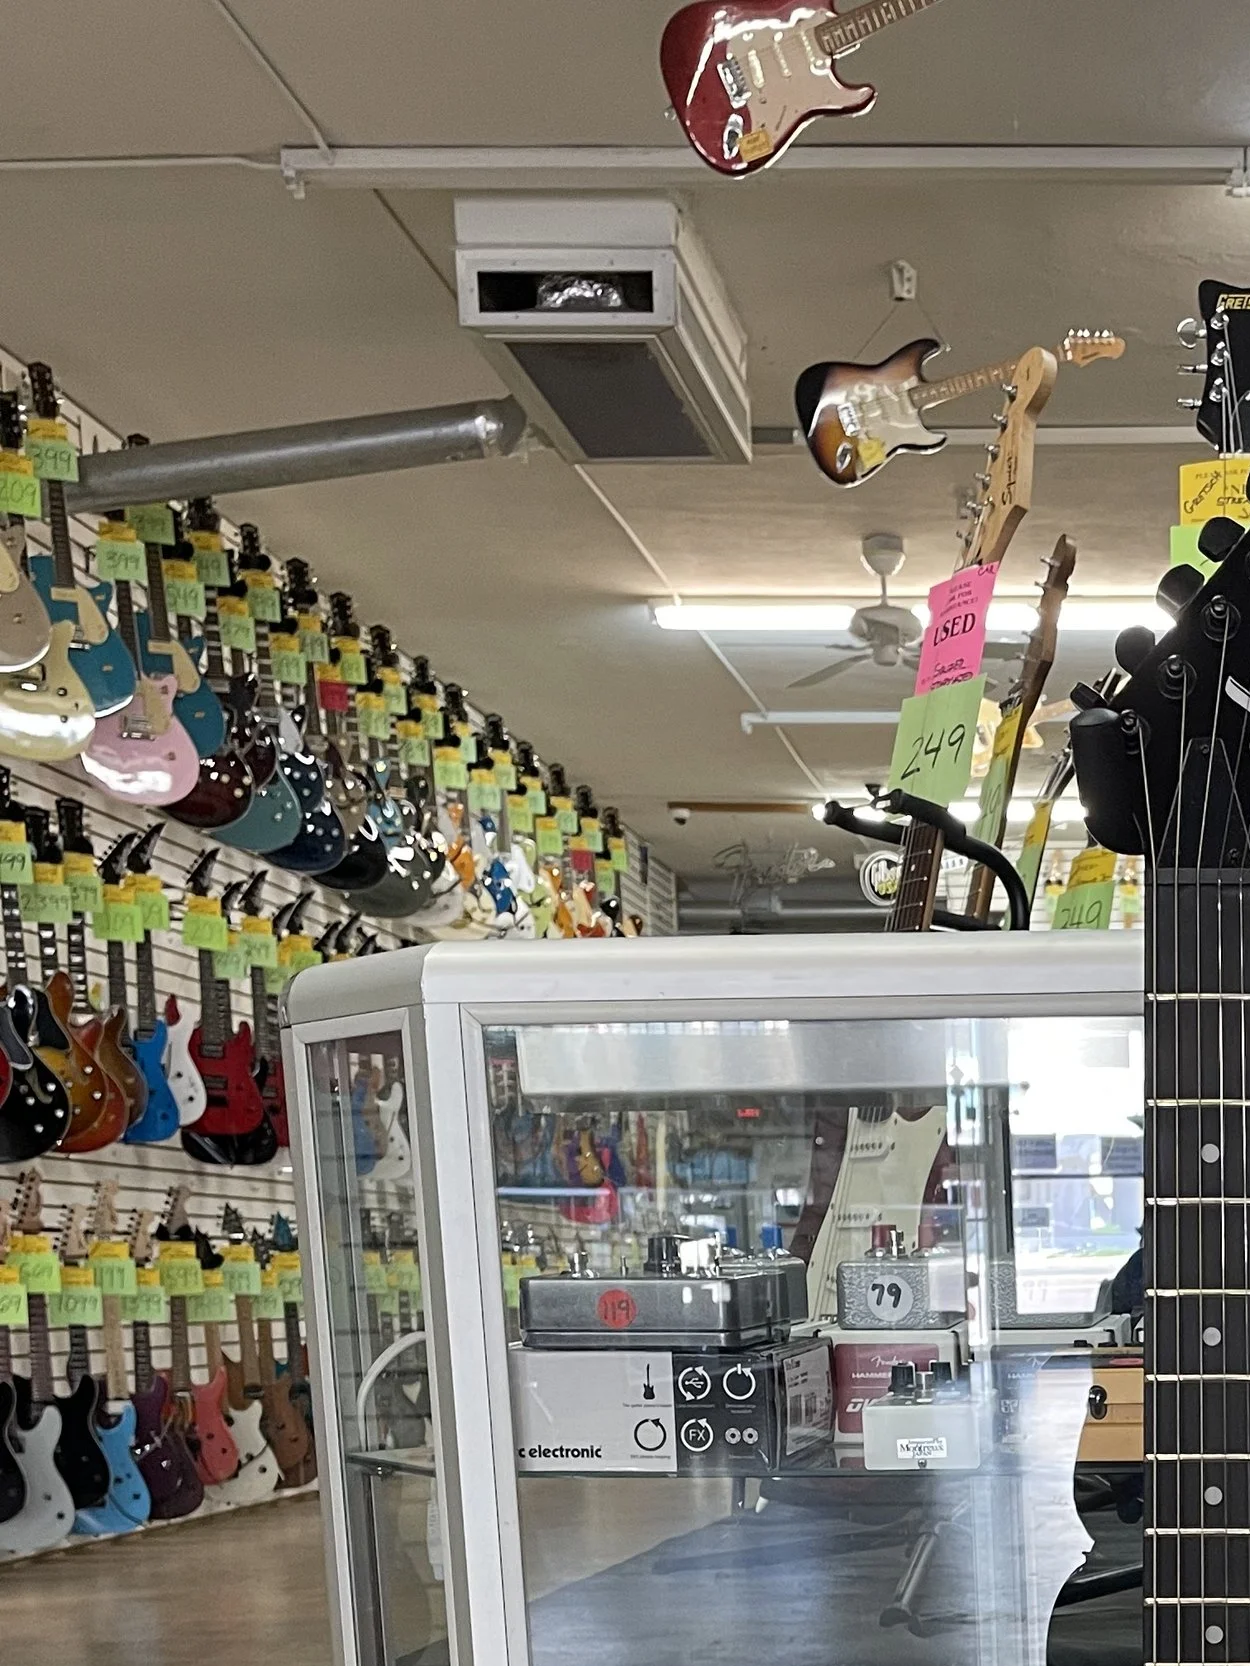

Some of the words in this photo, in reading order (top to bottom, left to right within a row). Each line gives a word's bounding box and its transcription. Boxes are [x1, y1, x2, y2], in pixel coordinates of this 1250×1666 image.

[901, 723, 966, 781] 249
[1061, 900, 1103, 929] 249
[871, 1282, 902, 1309] 79
[603, 1299, 630, 1321] 119
[689, 1428, 706, 1441] FX
[528, 1445, 603, 1459] electronic
